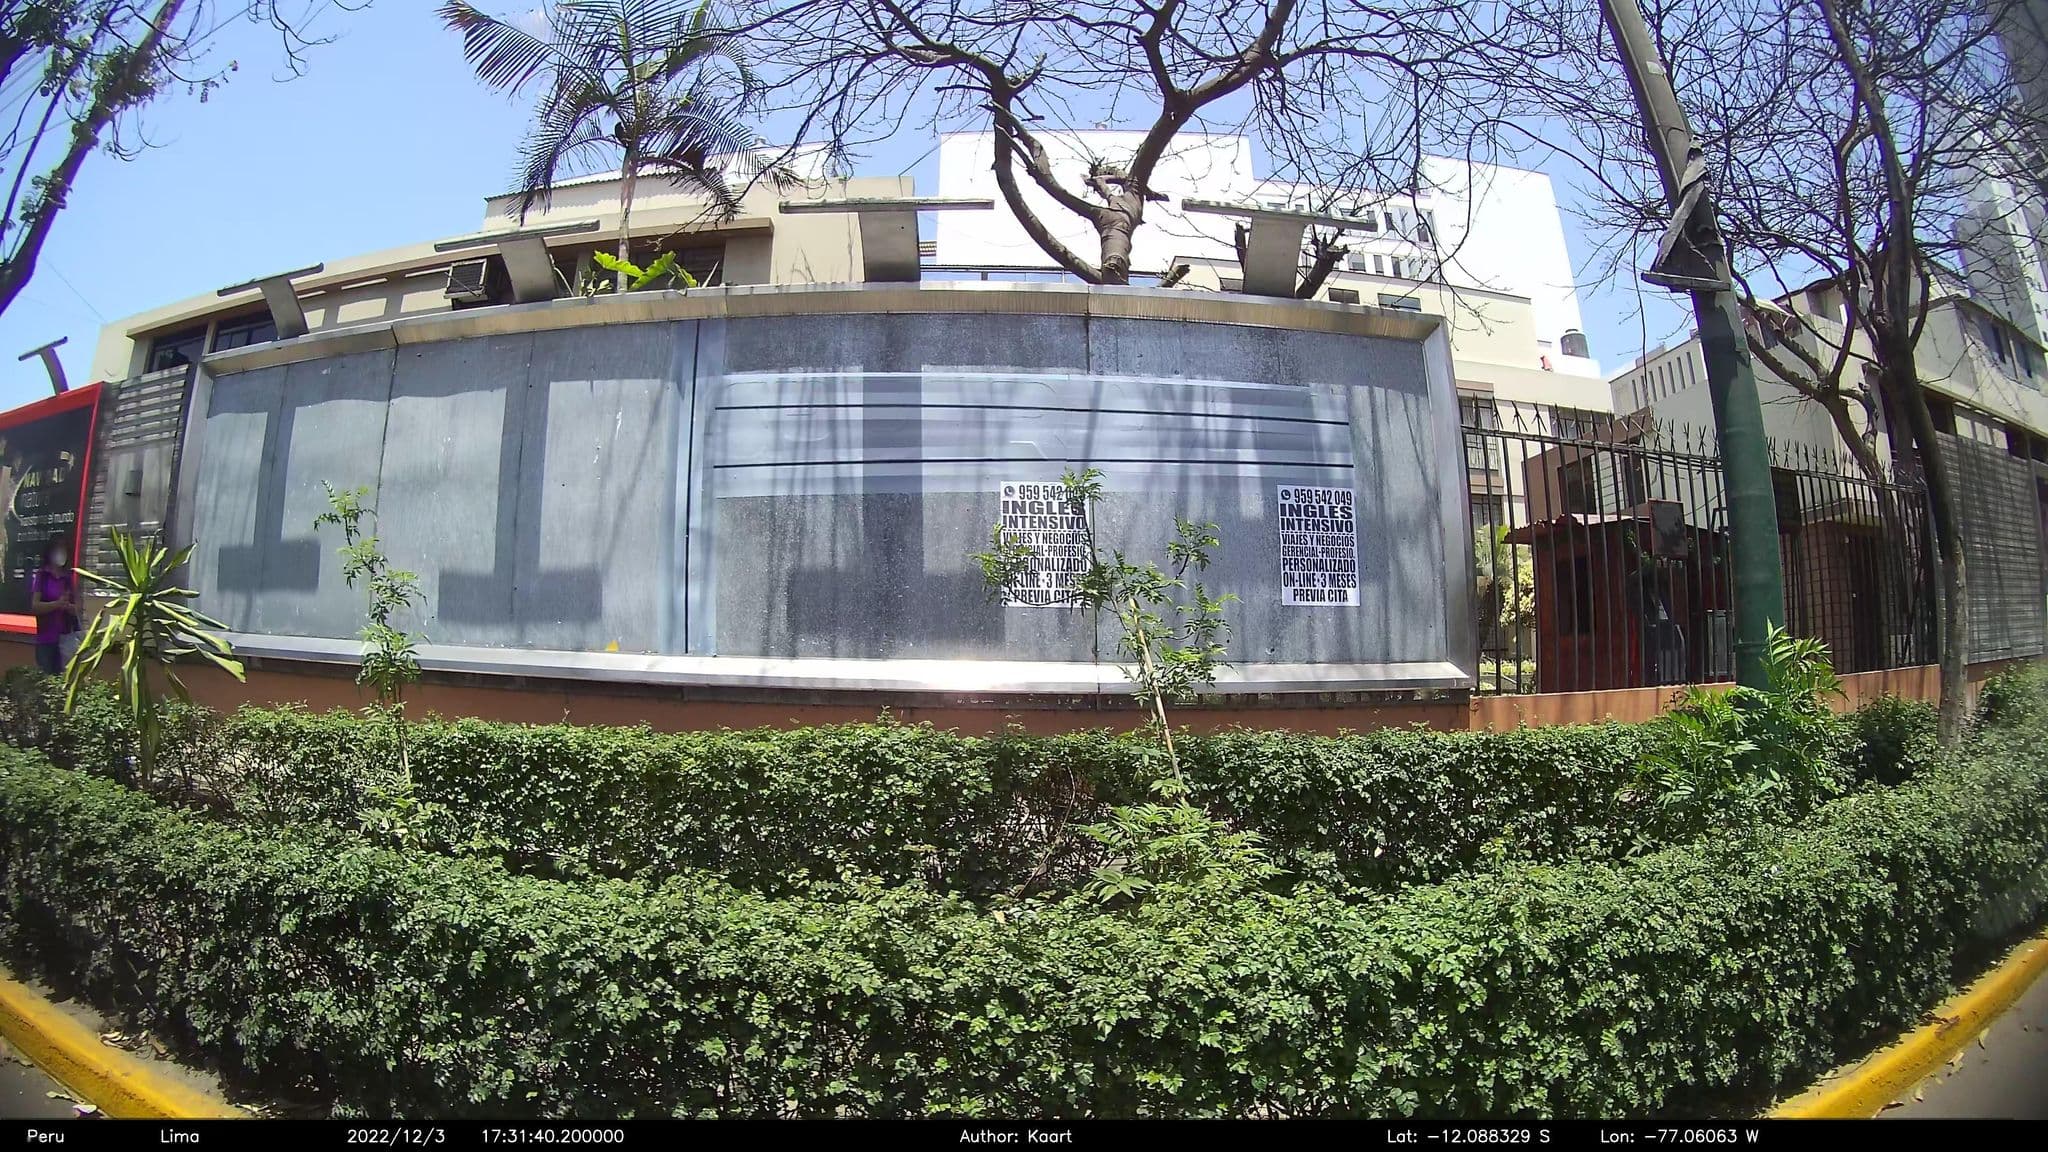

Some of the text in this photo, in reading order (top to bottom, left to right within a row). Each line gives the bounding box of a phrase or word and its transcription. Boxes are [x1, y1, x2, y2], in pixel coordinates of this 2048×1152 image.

[1019, 485, 1040, 500] 959
[1043, 485, 1063, 501] 542
[1294, 488, 1352, 505] 959 542 049
[1002, 500, 1085, 515] INGLES
[1280, 503, 1353, 519] INGLES
[1002, 515, 1086, 530] INTENSIVO
[1280, 518, 1353, 533] INTENSIVO
[1035, 533, 1040, 545] Y
[1281, 534, 1355, 547] VIAJES Y NEGOCIOS
[1282, 557, 1356, 573] PERSONALIZADO
[1328, 573, 1357, 589] MESES
[1014, 589, 1051, 603] PREVIA
[1293, 588, 1348, 603] PREVIA CITA
